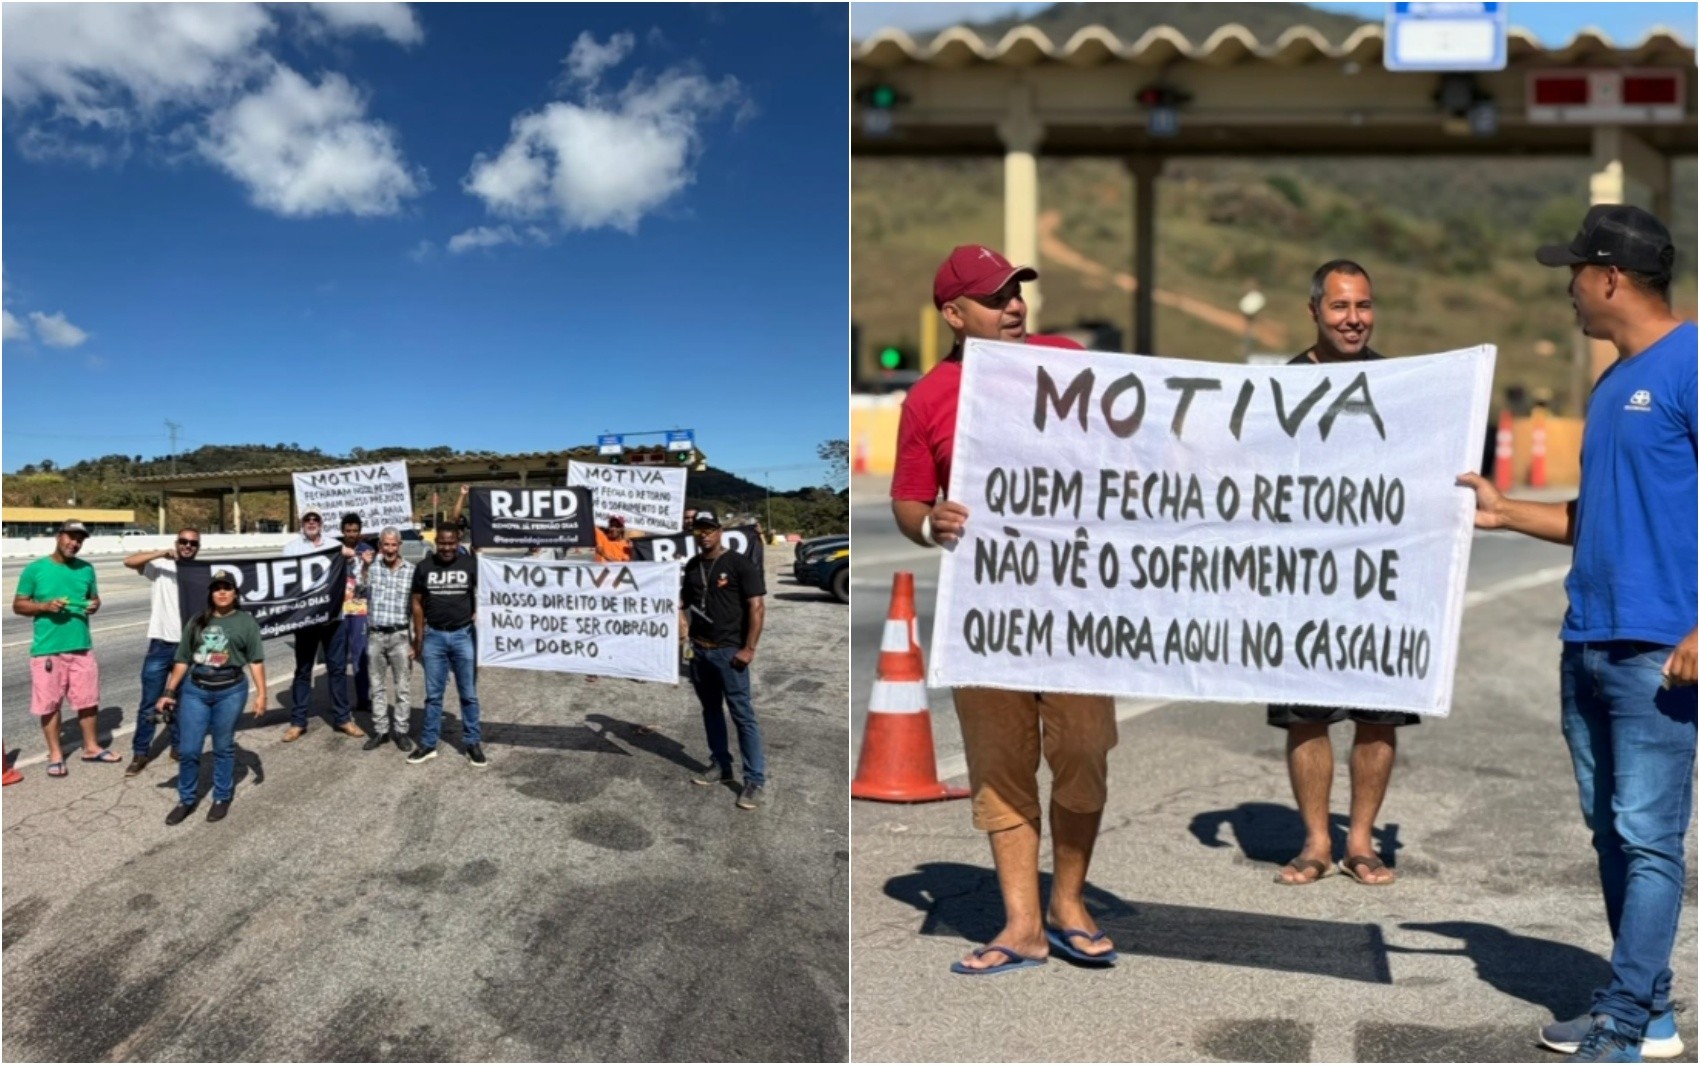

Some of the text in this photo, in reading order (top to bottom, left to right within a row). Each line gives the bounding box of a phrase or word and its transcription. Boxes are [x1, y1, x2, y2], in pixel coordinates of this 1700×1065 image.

[1033, 366, 1386, 442] MOTIVA
[311, 466, 390, 486] MOTIVA
[585, 467, 666, 485] MOTIVA
[490, 489, 578, 518] RJFD
[601, 486, 625, 498] FECHA
[636, 490, 671, 501] RETORNO
[985, 466, 1405, 526] QUEM FECHA O RETORNO
[658, 505, 669, 516] DE
[491, 522, 520, 530] RENOVA
[560, 521, 579, 529] DIAS
[652, 530, 749, 563] RJD
[974, 526, 1399, 601] NÃO VÊ O SOFRIMENTO DE
[428, 571, 468, 584] RJFD
[503, 564, 639, 592] MOTIVA
[308, 594, 330, 606] DIAS
[490, 591, 674, 614] NOSSO DIREITO DE IR E VIR
[260, 612, 329, 636] dojoseoficial
[491, 609, 669, 638] NÃO PODE SER COBRADO
[495, 636, 524, 652] EM
[536, 640, 599, 658] DOBRO
[963, 607, 1430, 680] QUEM MORA AQUI NO CASCALHO
